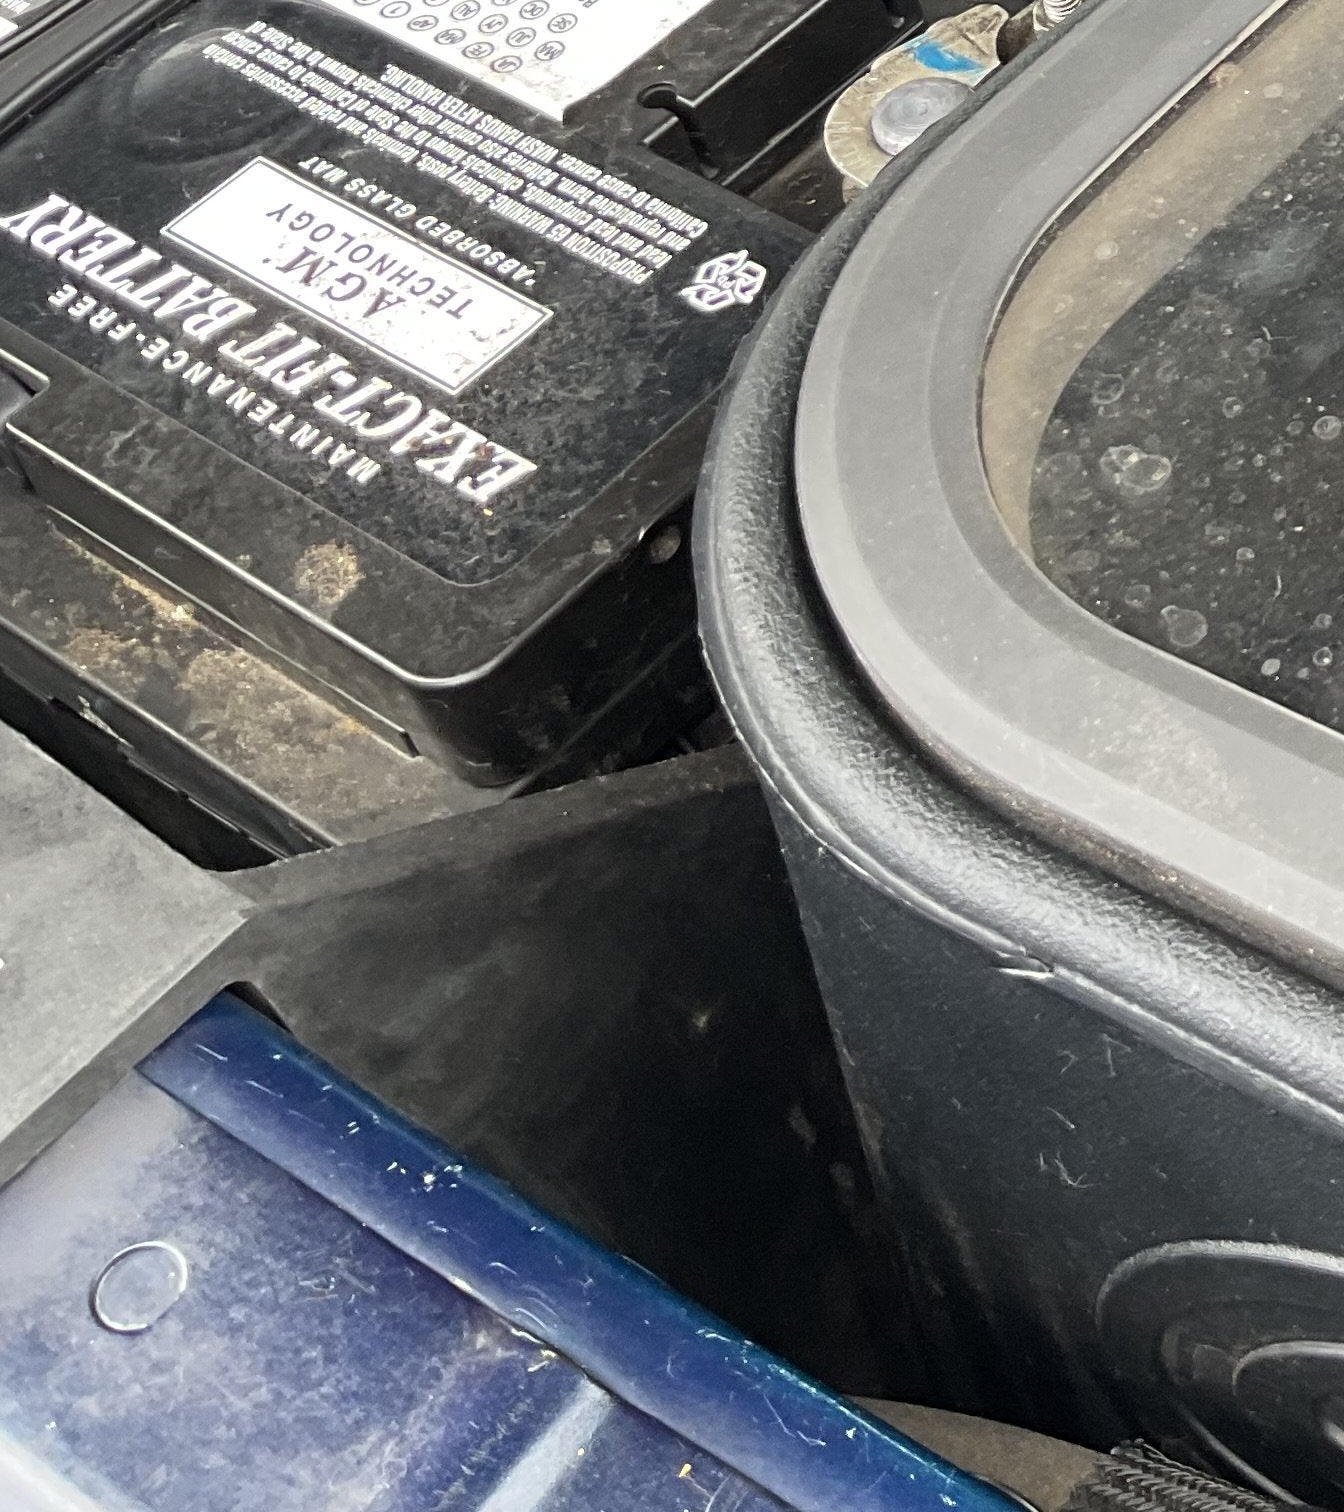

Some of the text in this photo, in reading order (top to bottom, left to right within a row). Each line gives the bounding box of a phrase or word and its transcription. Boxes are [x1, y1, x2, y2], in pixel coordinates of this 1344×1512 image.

[195, 41, 656, 286] PROPOSITION 65 WARNING: Battery posts, terminals and related accessories contain
[217, 27, 675, 269] lead and lead compounds, chemicals known to the State of California to cause cancer
[242, 18, 694, 254] and reproductive harm. Batteries also contain other chemicals known to the State of
[297, 154, 349, 184] MAT
[343, 174, 418, 221] GLASS
[373, 62, 711, 239] California to cause cancer. WASH HANDS AFTER HANDLING.
[0, 191, 539, 502] EXACT-FIT BATTERY
[261, 198, 479, 320] TECHNOLOGY
